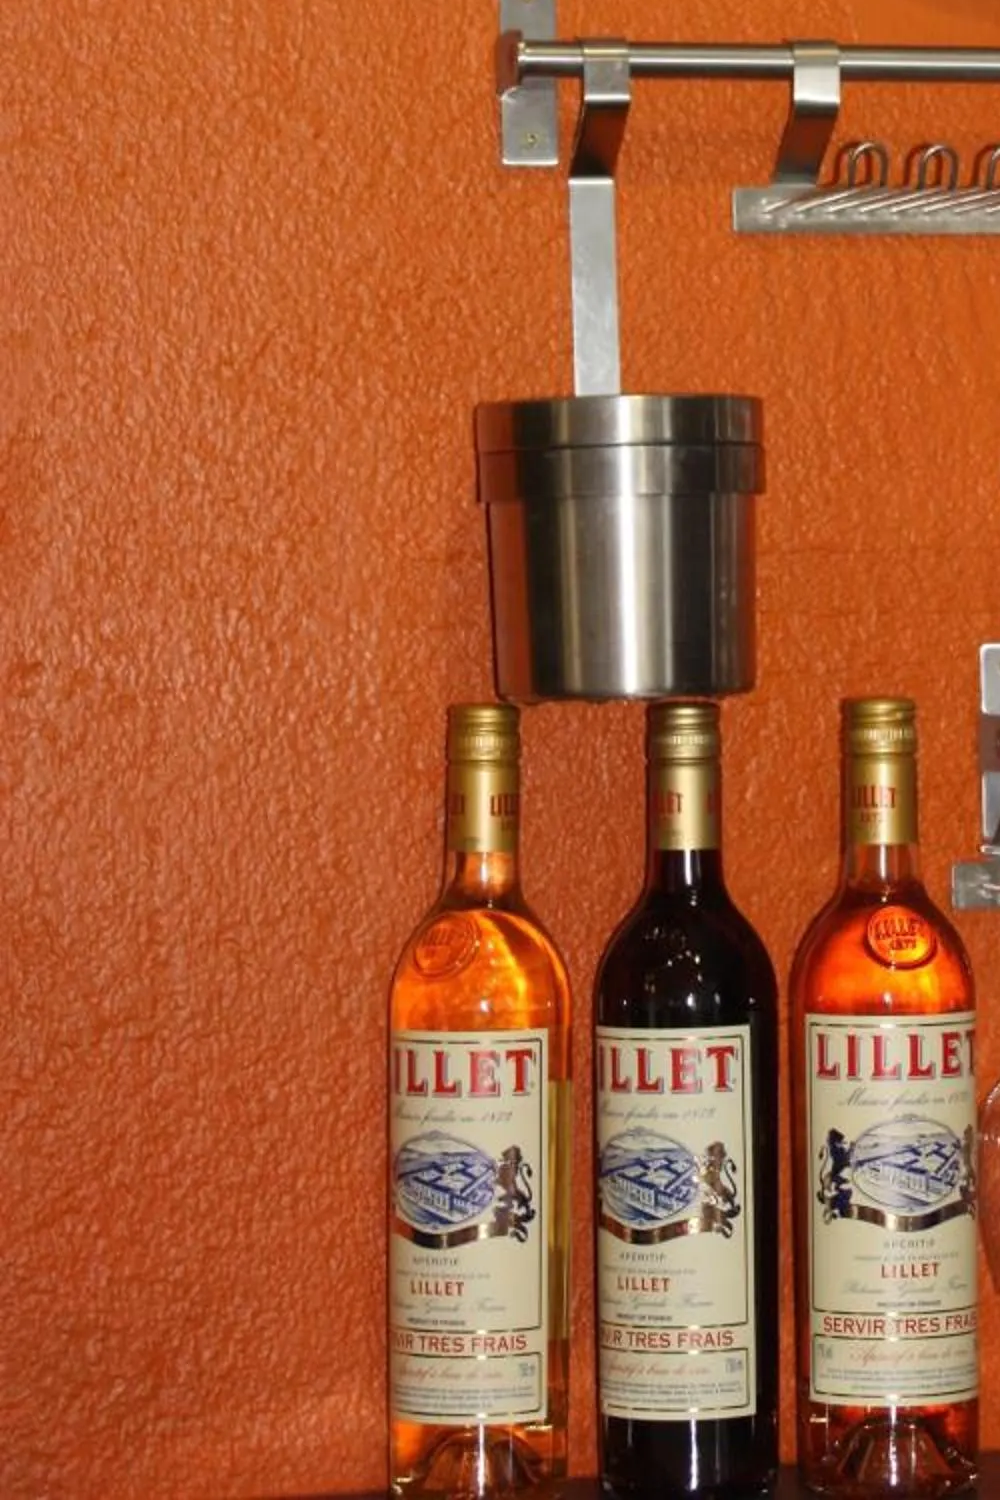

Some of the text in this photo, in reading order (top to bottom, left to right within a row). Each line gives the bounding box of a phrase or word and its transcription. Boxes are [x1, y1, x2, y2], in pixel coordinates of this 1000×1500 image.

[881, 1261, 941, 1279] LILLET
[410, 1280, 464, 1297] LILLET
[617, 1275, 670, 1293] LILLET
[823, 1315, 885, 1335] SERVIR
[893, 1317, 940, 1334] TRES
[418, 1334, 465, 1353] TRES
[471, 1333, 527, 1353] FRAIS
[626, 1330, 671, 1349] TRES
[678, 1330, 734, 1349] FRAIS
